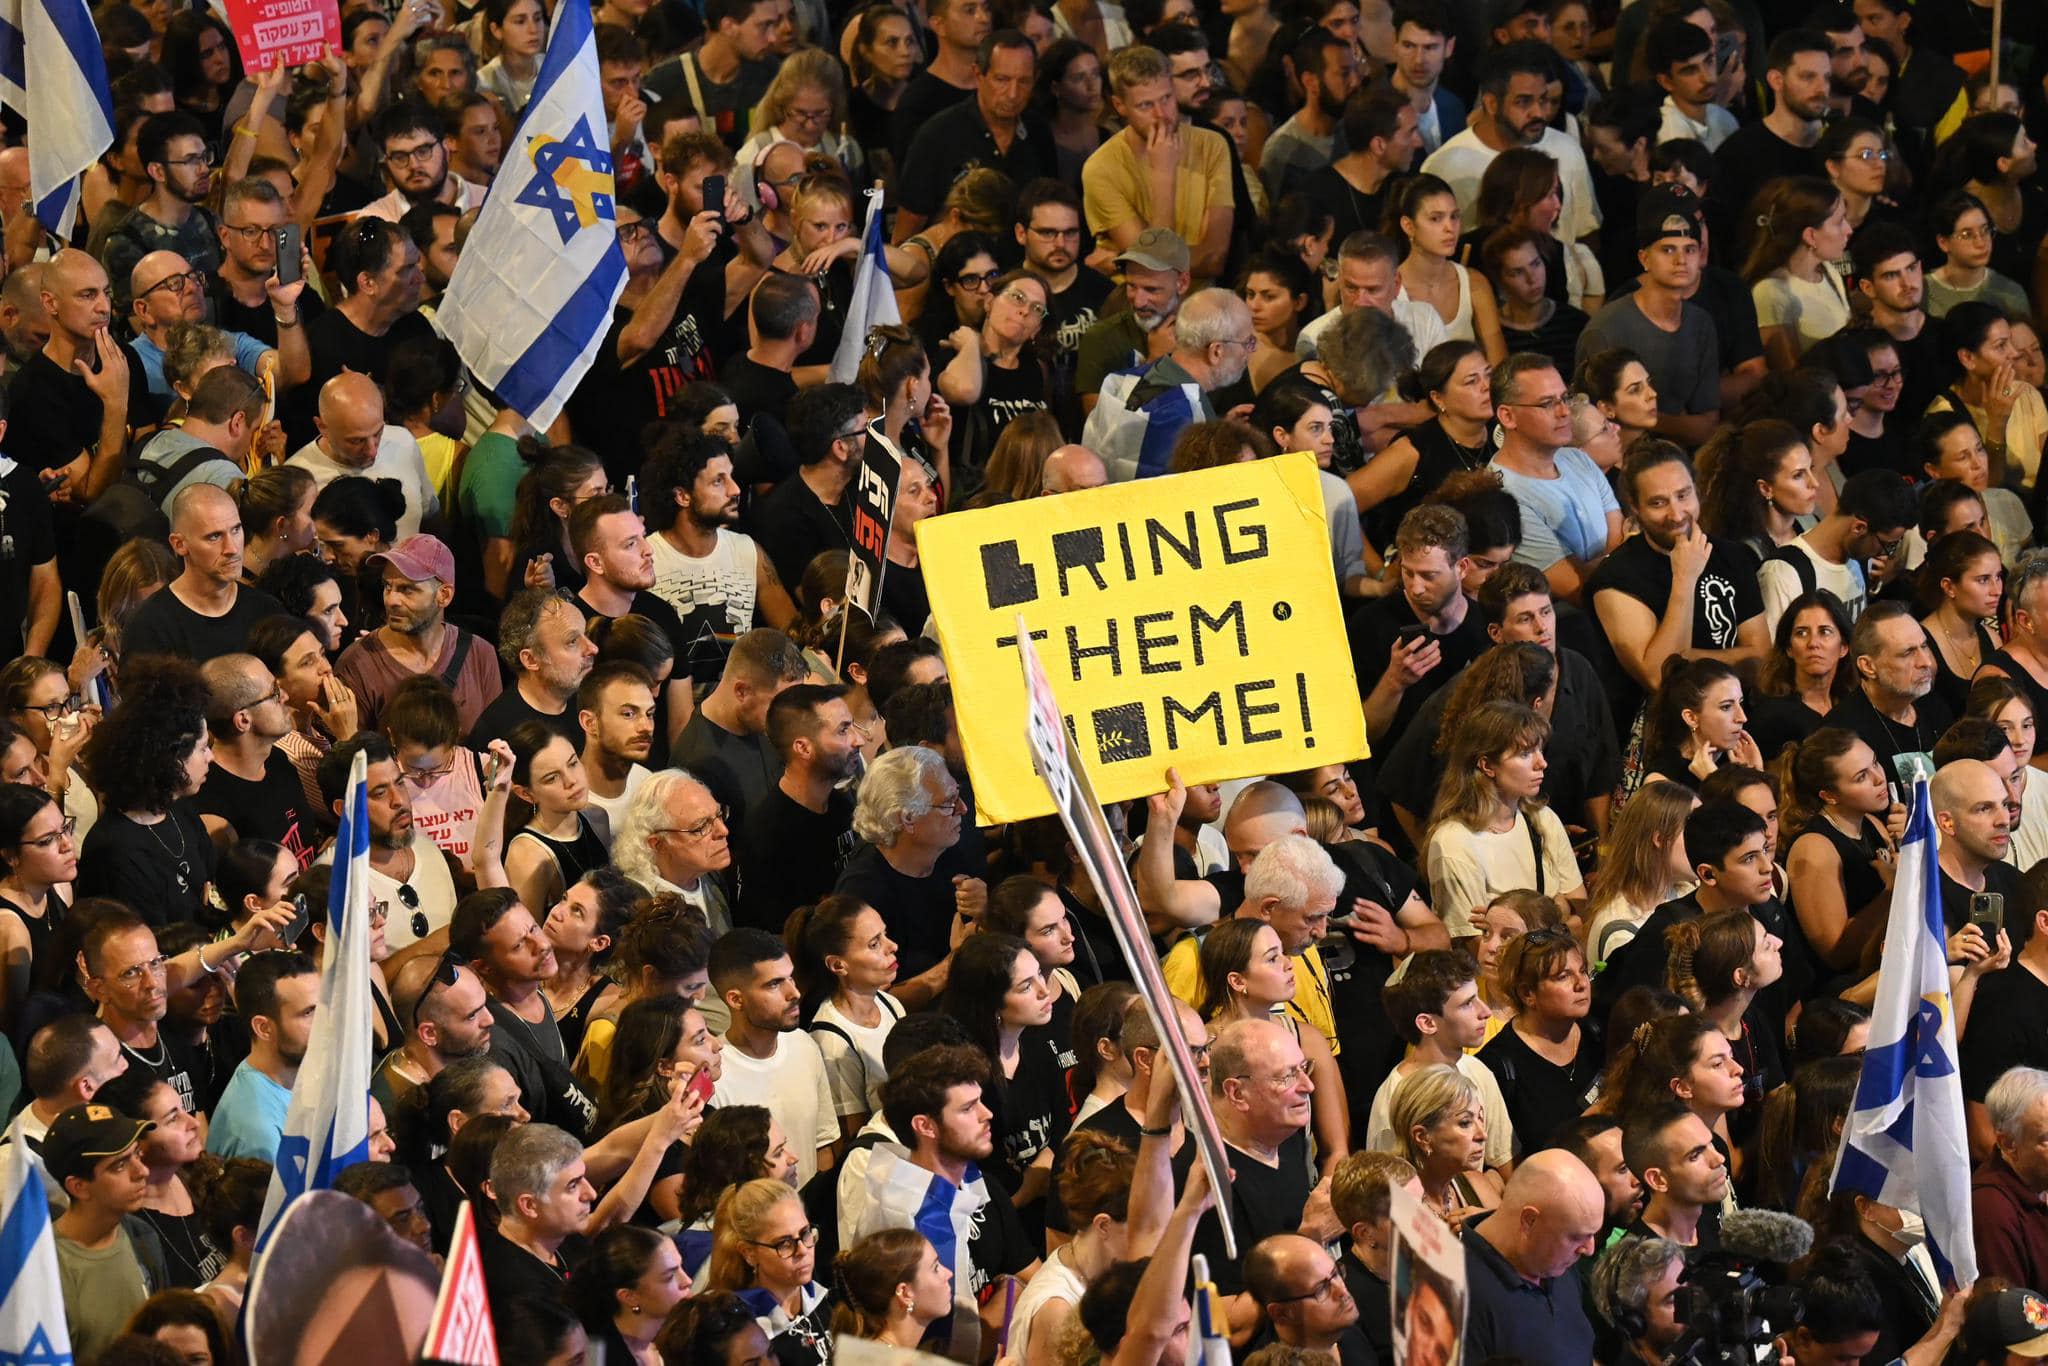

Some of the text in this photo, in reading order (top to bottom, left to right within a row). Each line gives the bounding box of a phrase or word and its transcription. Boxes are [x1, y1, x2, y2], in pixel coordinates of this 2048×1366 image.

[259, 18, 321, 42] רק עסקה
[980, 497, 1270, 611] BRING
[1034, 672, 1316, 777] OME!
[453, 808, 474, 822] לא
[427, 828, 451, 841] עד
